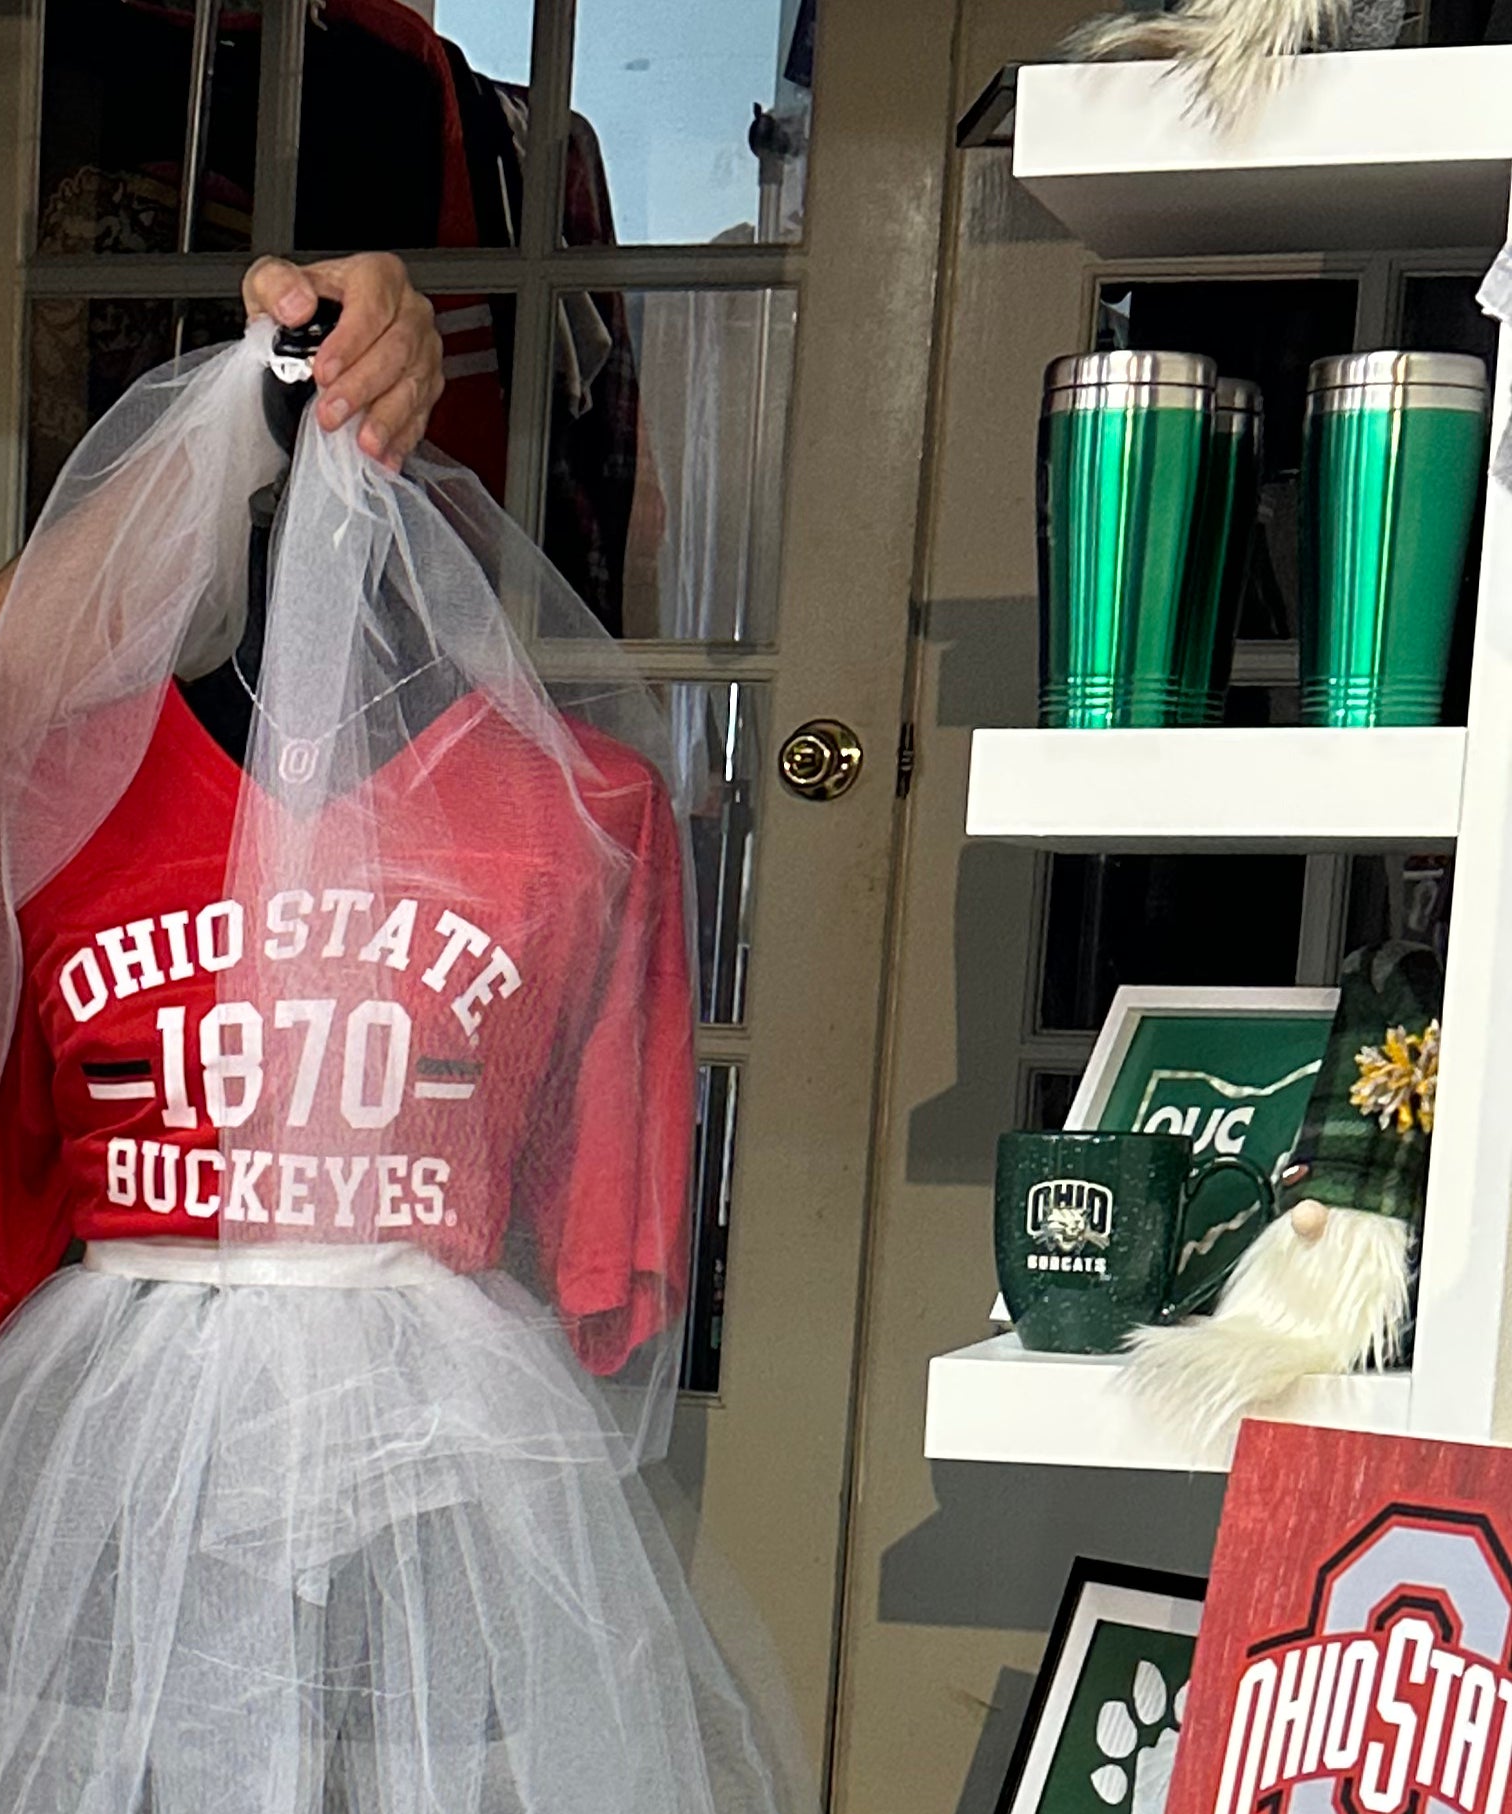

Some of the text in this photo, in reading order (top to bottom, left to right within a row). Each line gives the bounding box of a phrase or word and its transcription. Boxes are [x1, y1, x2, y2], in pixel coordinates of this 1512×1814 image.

[58, 888, 523, 1037] OHIO STATE
[156, 999, 412, 1130] 1870
[106, 1137, 451, 1228] BUCKEYES
[1027, 1179, 1113, 1238] OHIO
